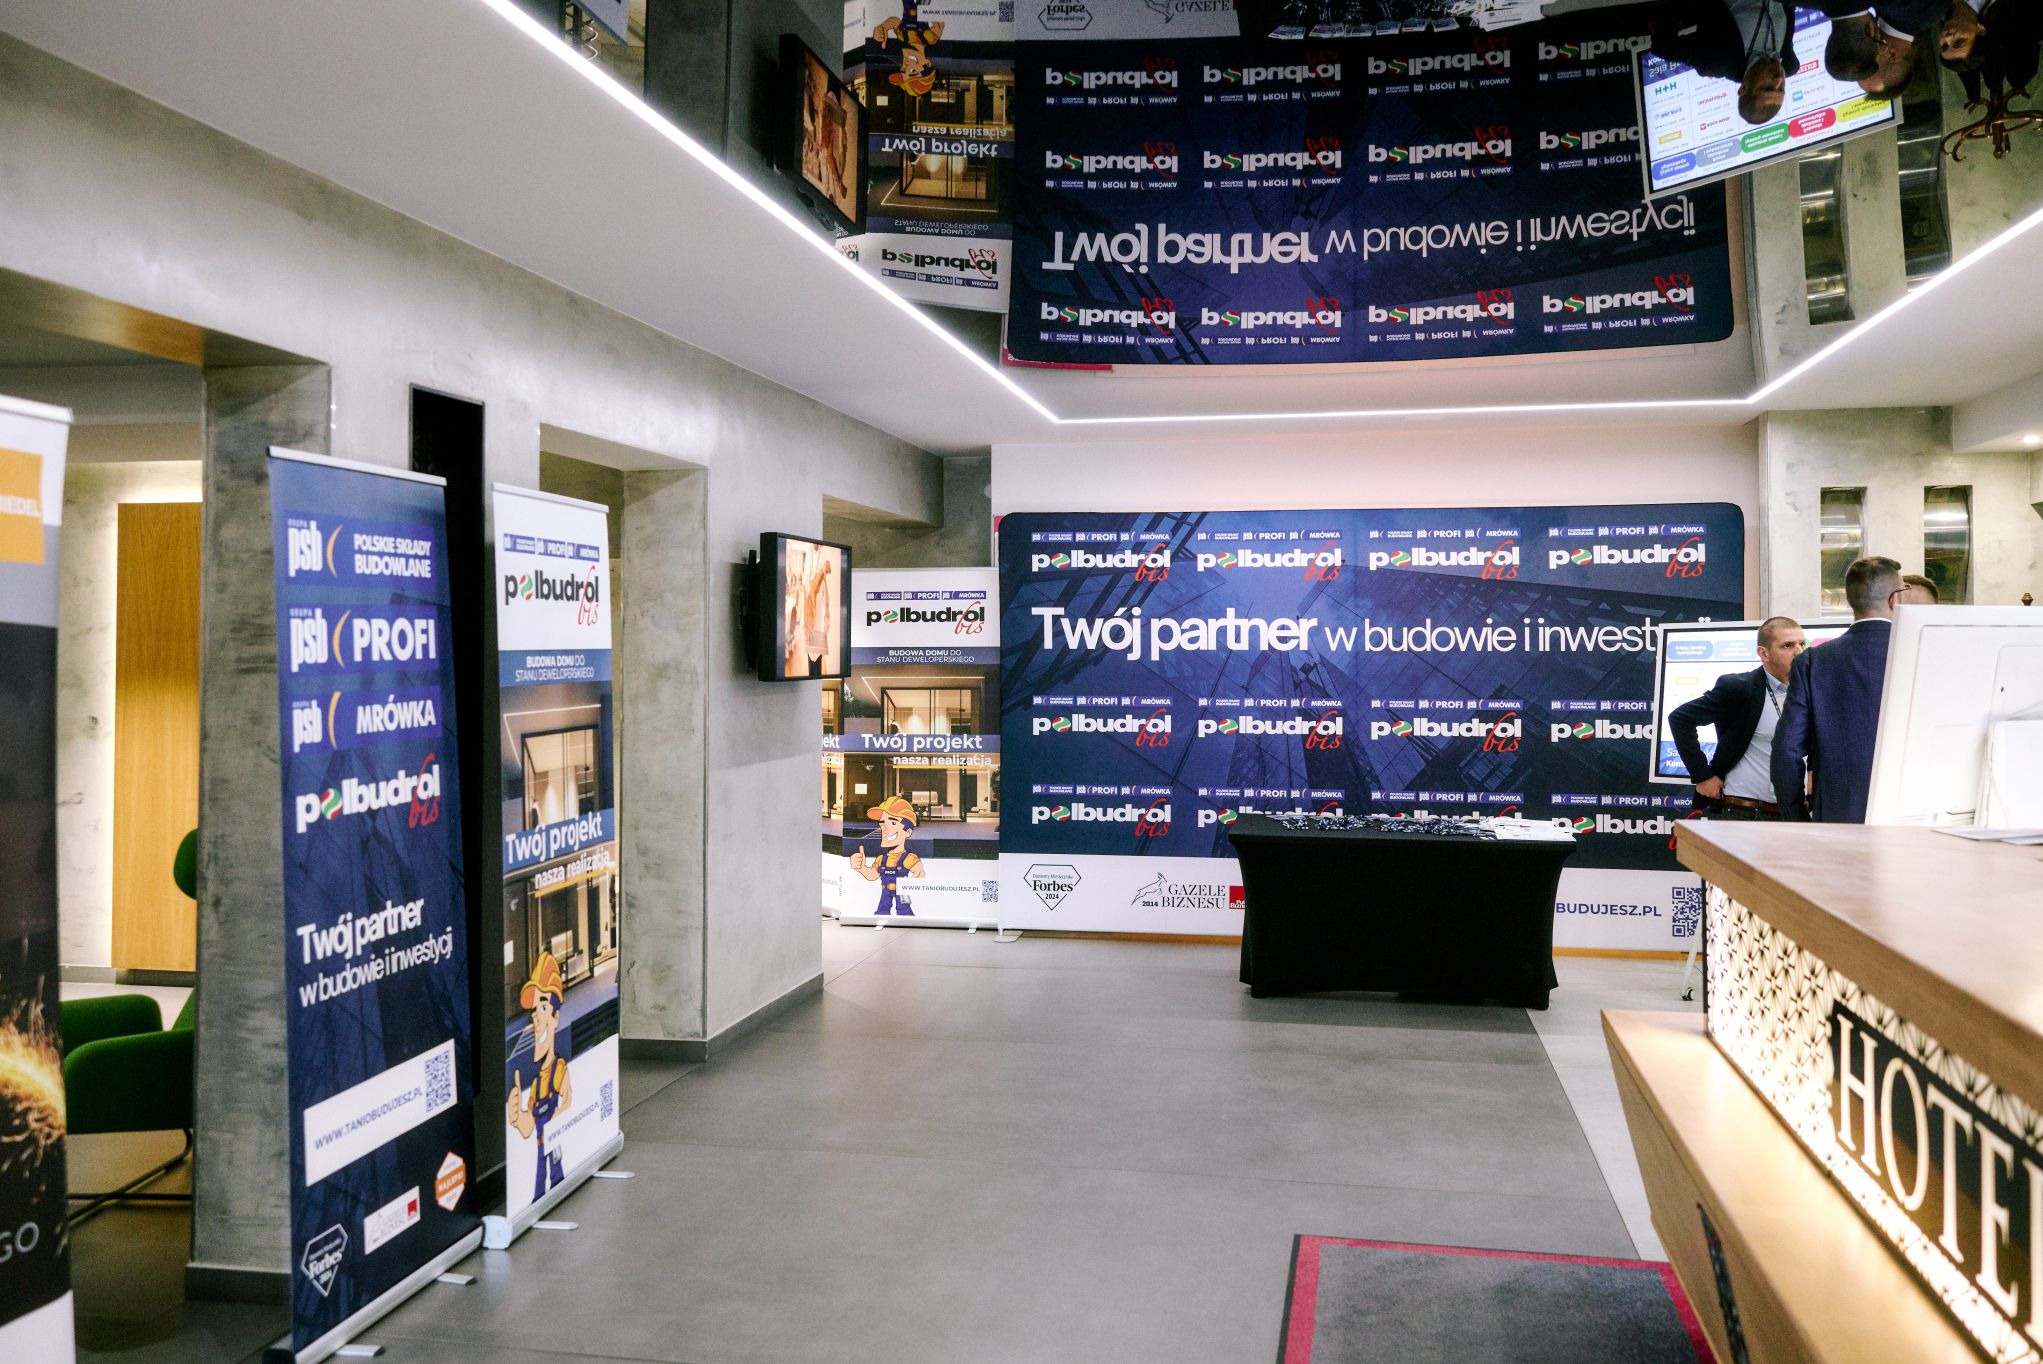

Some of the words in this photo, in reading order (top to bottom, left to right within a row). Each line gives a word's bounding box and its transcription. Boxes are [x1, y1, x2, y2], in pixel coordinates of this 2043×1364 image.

[1486, 529, 1518, 537] MRÓWKA
[1671, 525, 1704, 533] MRÓWKA
[354, 534, 396, 552] POLSKIE
[396, 537, 432, 556] SKŁADY
[1549, 543, 1705, 569] polbudrol
[354, 554, 432, 578] BUDOWLANE
[1032, 550, 1171, 571] polbudrol
[1135, 544, 1169, 582] bis
[1197, 548, 1341, 571] polbudrol
[1305, 542, 1340, 581] bis
[1369, 547, 1519, 570] polbudrol
[1481, 540, 1518, 579] bis
[1665, 537, 1704, 578] bis
[505, 570, 598, 606] polbudrol
[867, 606, 984, 626] polbudrol
[954, 601, 984, 634] bis
[352, 617, 436, 662] PROFI
[1031, 606, 1142, 661] Twój
[1151, 607, 1317, 661] partner
[1324, 626, 1357, 651] w
[1364, 618, 1517, 652] budowie
[1523, 618, 1530, 651] i
[1538, 617, 1660, 652] inwest
[526, 656, 556, 668] BUDOWA
[556, 656, 575, 667] DOMU
[576, 654, 585, 666] DO
[516, 670, 538, 682] STANU
[1141, 697, 1170, 705] MRÓWKA
[1311, 699, 1341, 707] MRÓWKA
[356, 694, 436, 734] MRÓWKA
[1033, 714, 1171, 735] polbudrol
[1136, 708, 1170, 747] bis
[1198, 716, 1343, 737] polbudrol
[1306, 710, 1341, 749] bis
[1371, 718, 1521, 740] polbudrol
[1483, 712, 1520, 751] bis
[861, 734, 907, 752] Twój
[914, 734, 982, 752] projekt
[893, 756, 928, 766] nasza
[932, 753, 992, 767] realizacja
[296, 764, 440, 834] polbudrol
[408, 753, 440, 829] bis
[1489, 793, 1522, 801] MRÓWKA
[1032, 803, 1171, 824] polbudrol
[1136, 798, 1170, 836] bis
[506, 825, 546, 864] Twój
[550, 811, 602, 858] projekt
[534, 864, 566, 890] nasza
[1032, 880, 1074, 892] Forbes
[1168, 884, 1226, 897] GAZELE
[1162, 896, 1226, 910] BIZNESU
[1556, 902, 1662, 916] BUDUJESZ.PL
[296, 912, 353, 965] Twój
[355, 898, 424, 956] partner
[299, 982, 317, 1008] w
[319, 954, 384, 1002] budowie
